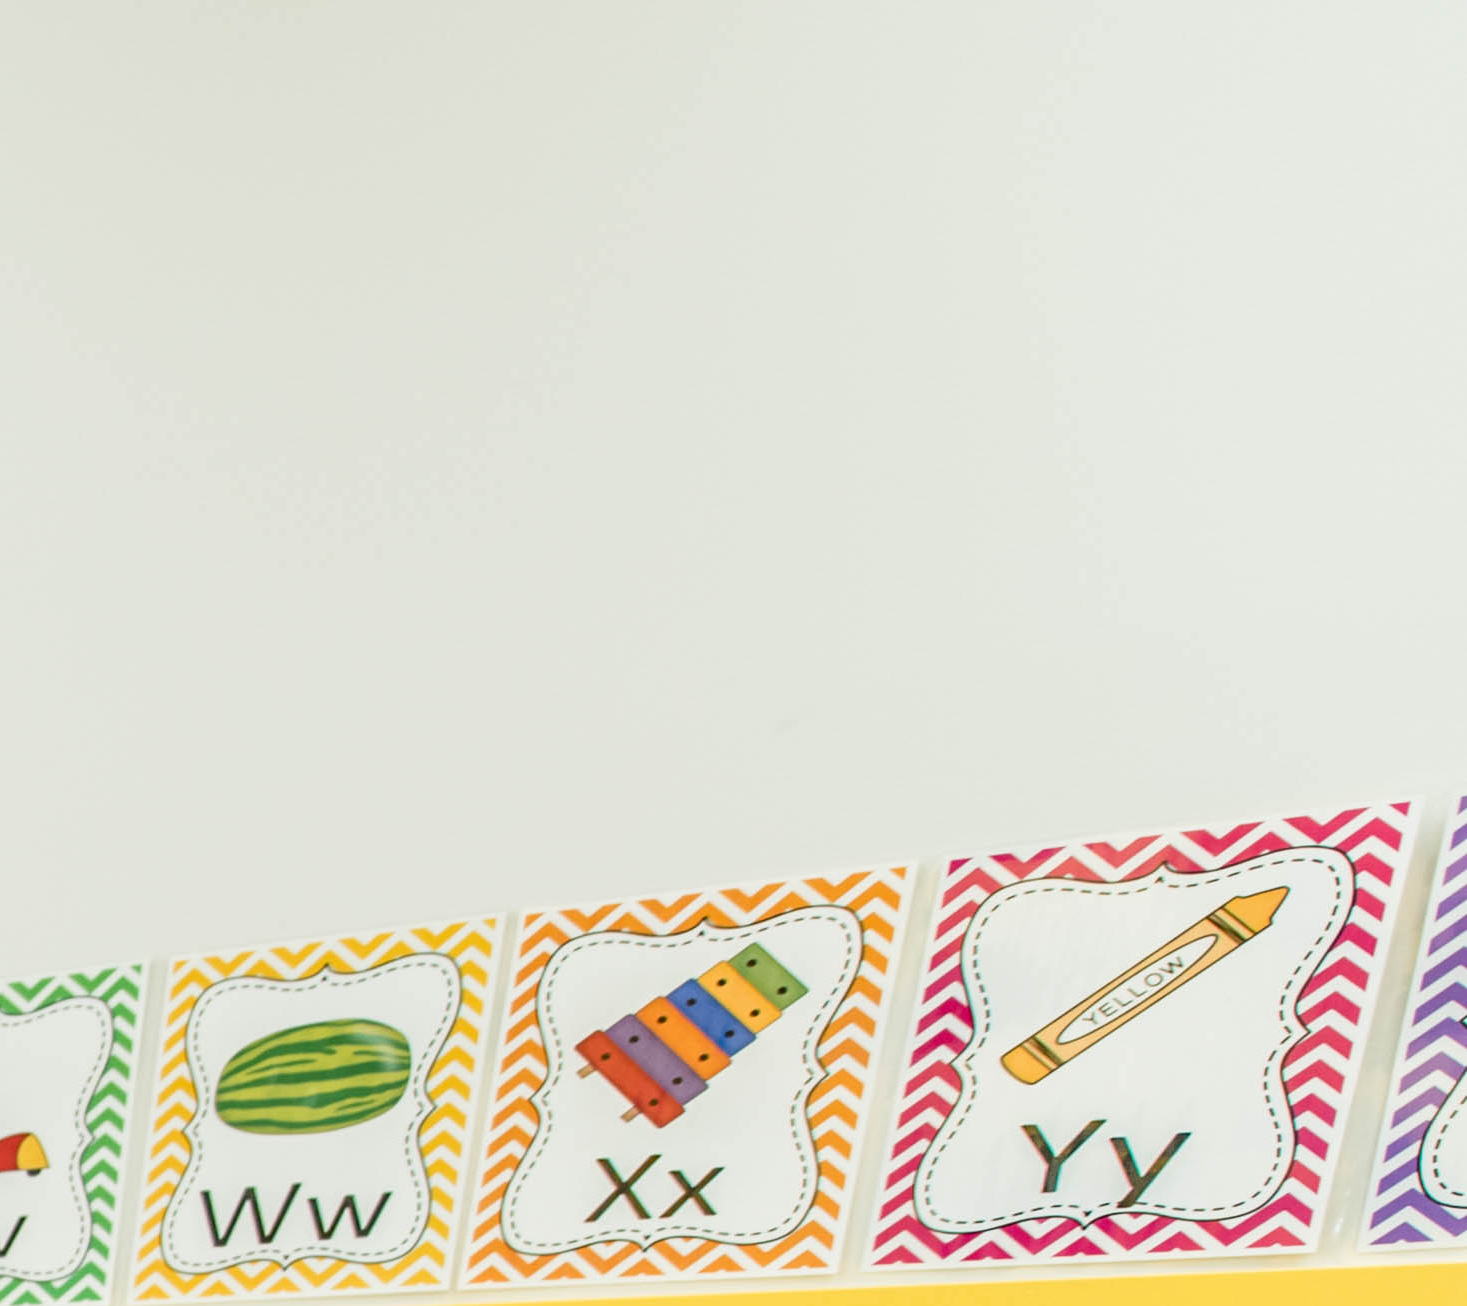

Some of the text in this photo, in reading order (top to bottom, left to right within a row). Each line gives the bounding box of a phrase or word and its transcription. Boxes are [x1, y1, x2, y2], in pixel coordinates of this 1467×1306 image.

[1081, 955, 1186, 1027] YELLOW
[583, 1154, 727, 1224] Xx
[1020, 1118, 1193, 1209] Yy
[199, 1181, 395, 1248] Ww
